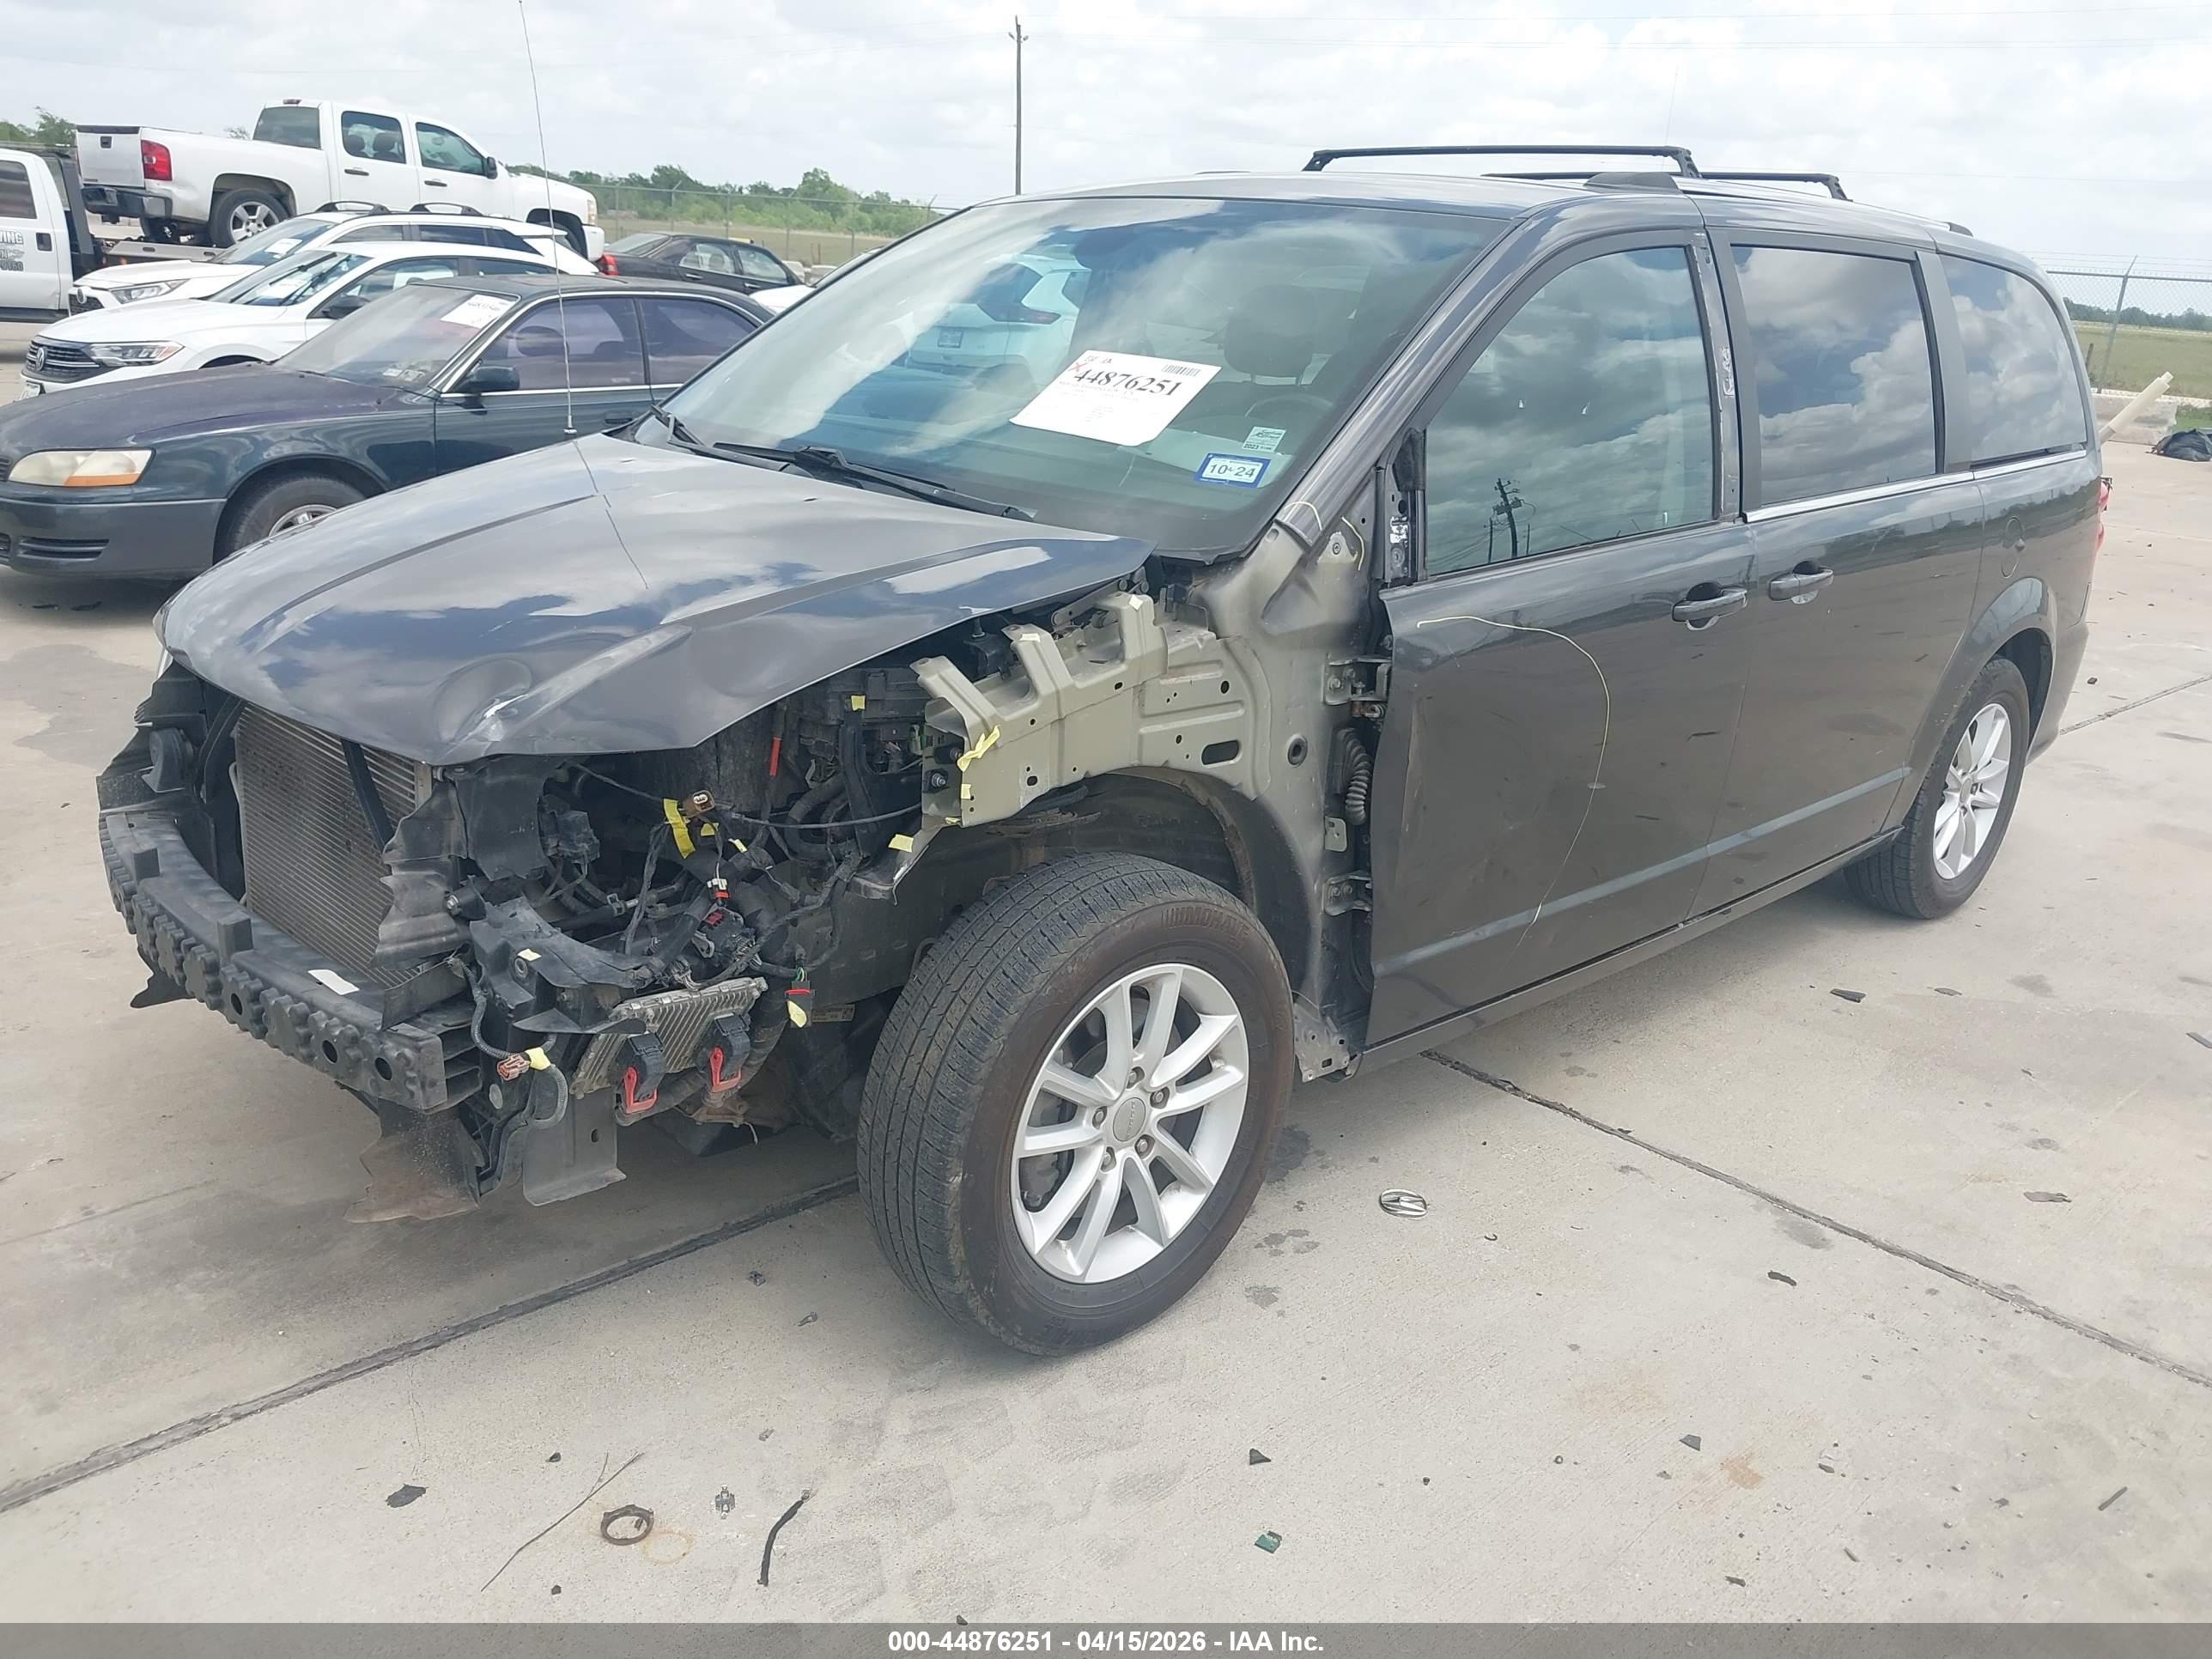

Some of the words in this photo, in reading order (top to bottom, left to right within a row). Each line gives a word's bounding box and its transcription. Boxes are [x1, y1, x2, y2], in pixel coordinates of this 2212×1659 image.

[1073, 368, 1182, 396] 44876251
[1209, 464, 1229, 475] 10
[1234, 466, 1256, 478] 24
